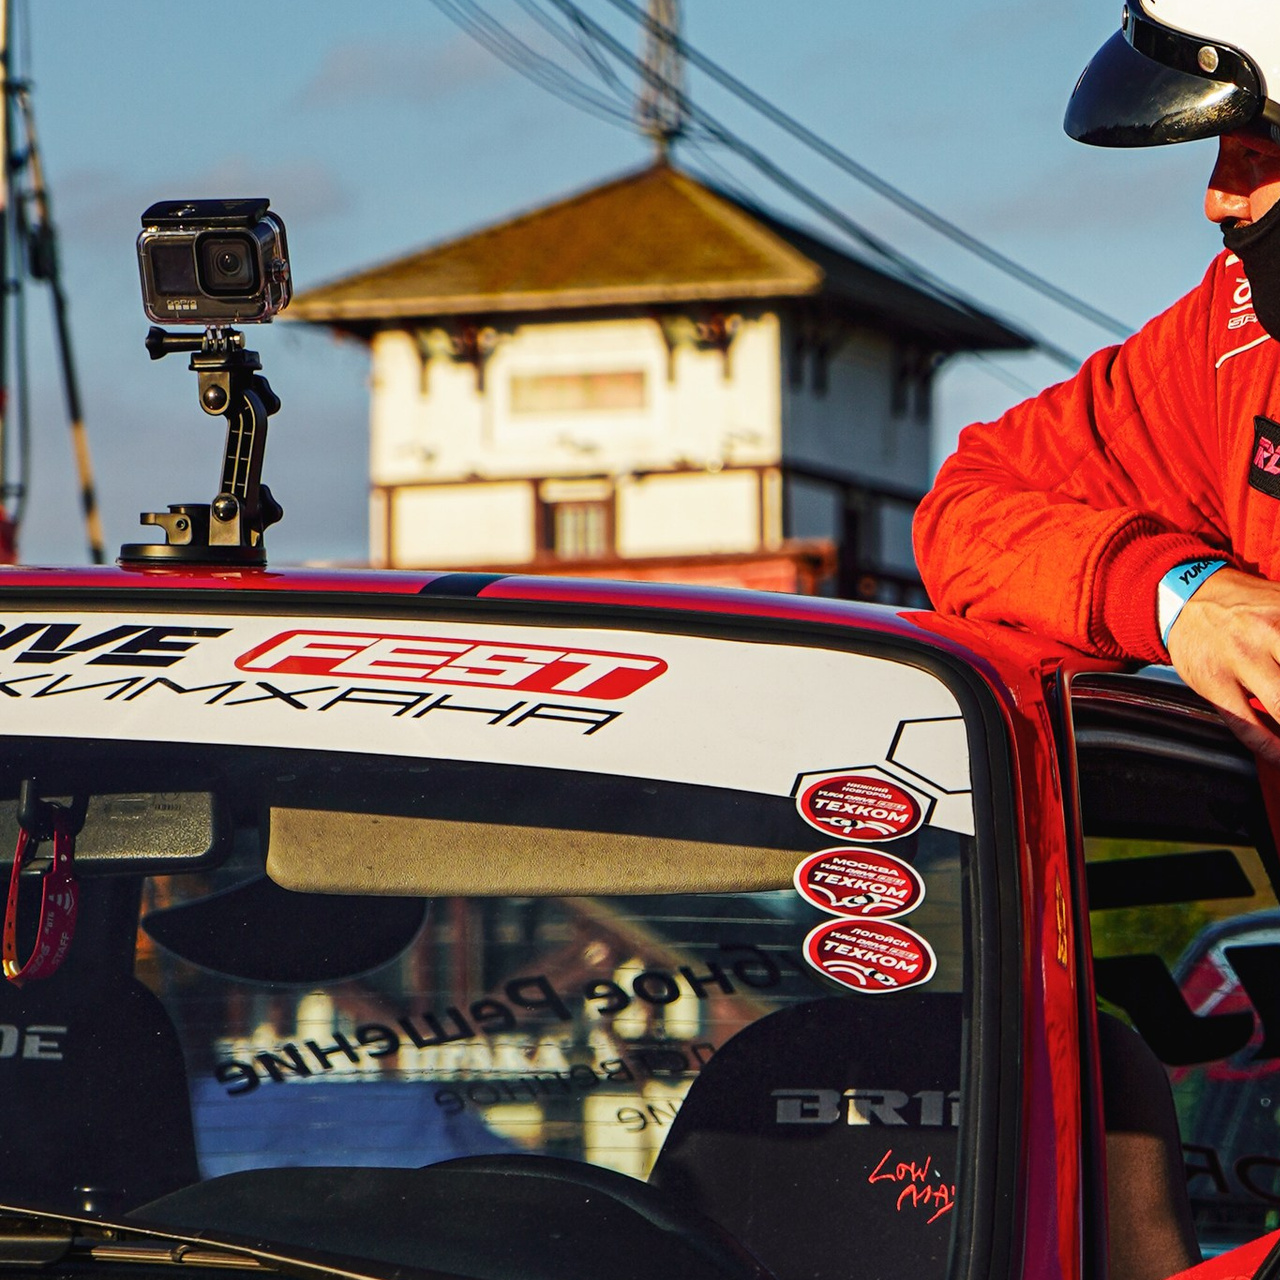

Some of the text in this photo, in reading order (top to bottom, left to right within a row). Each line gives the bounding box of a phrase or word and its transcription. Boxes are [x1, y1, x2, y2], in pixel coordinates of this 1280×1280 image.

[1178, 558, 1214, 586] YUKA
[0, 622, 663, 694] IVE FEST
[818, 790, 845, 799] YUKA
[841, 786, 892, 800] НОВГОРОД
[846, 782, 889, 793] НИЖНИЙ
[820, 862, 845, 873] YUKA
[832, 857, 899, 876] МОСКВА
[830, 931, 857, 942] YUKA
[850, 928, 911, 948] ЛОГОЙСК
